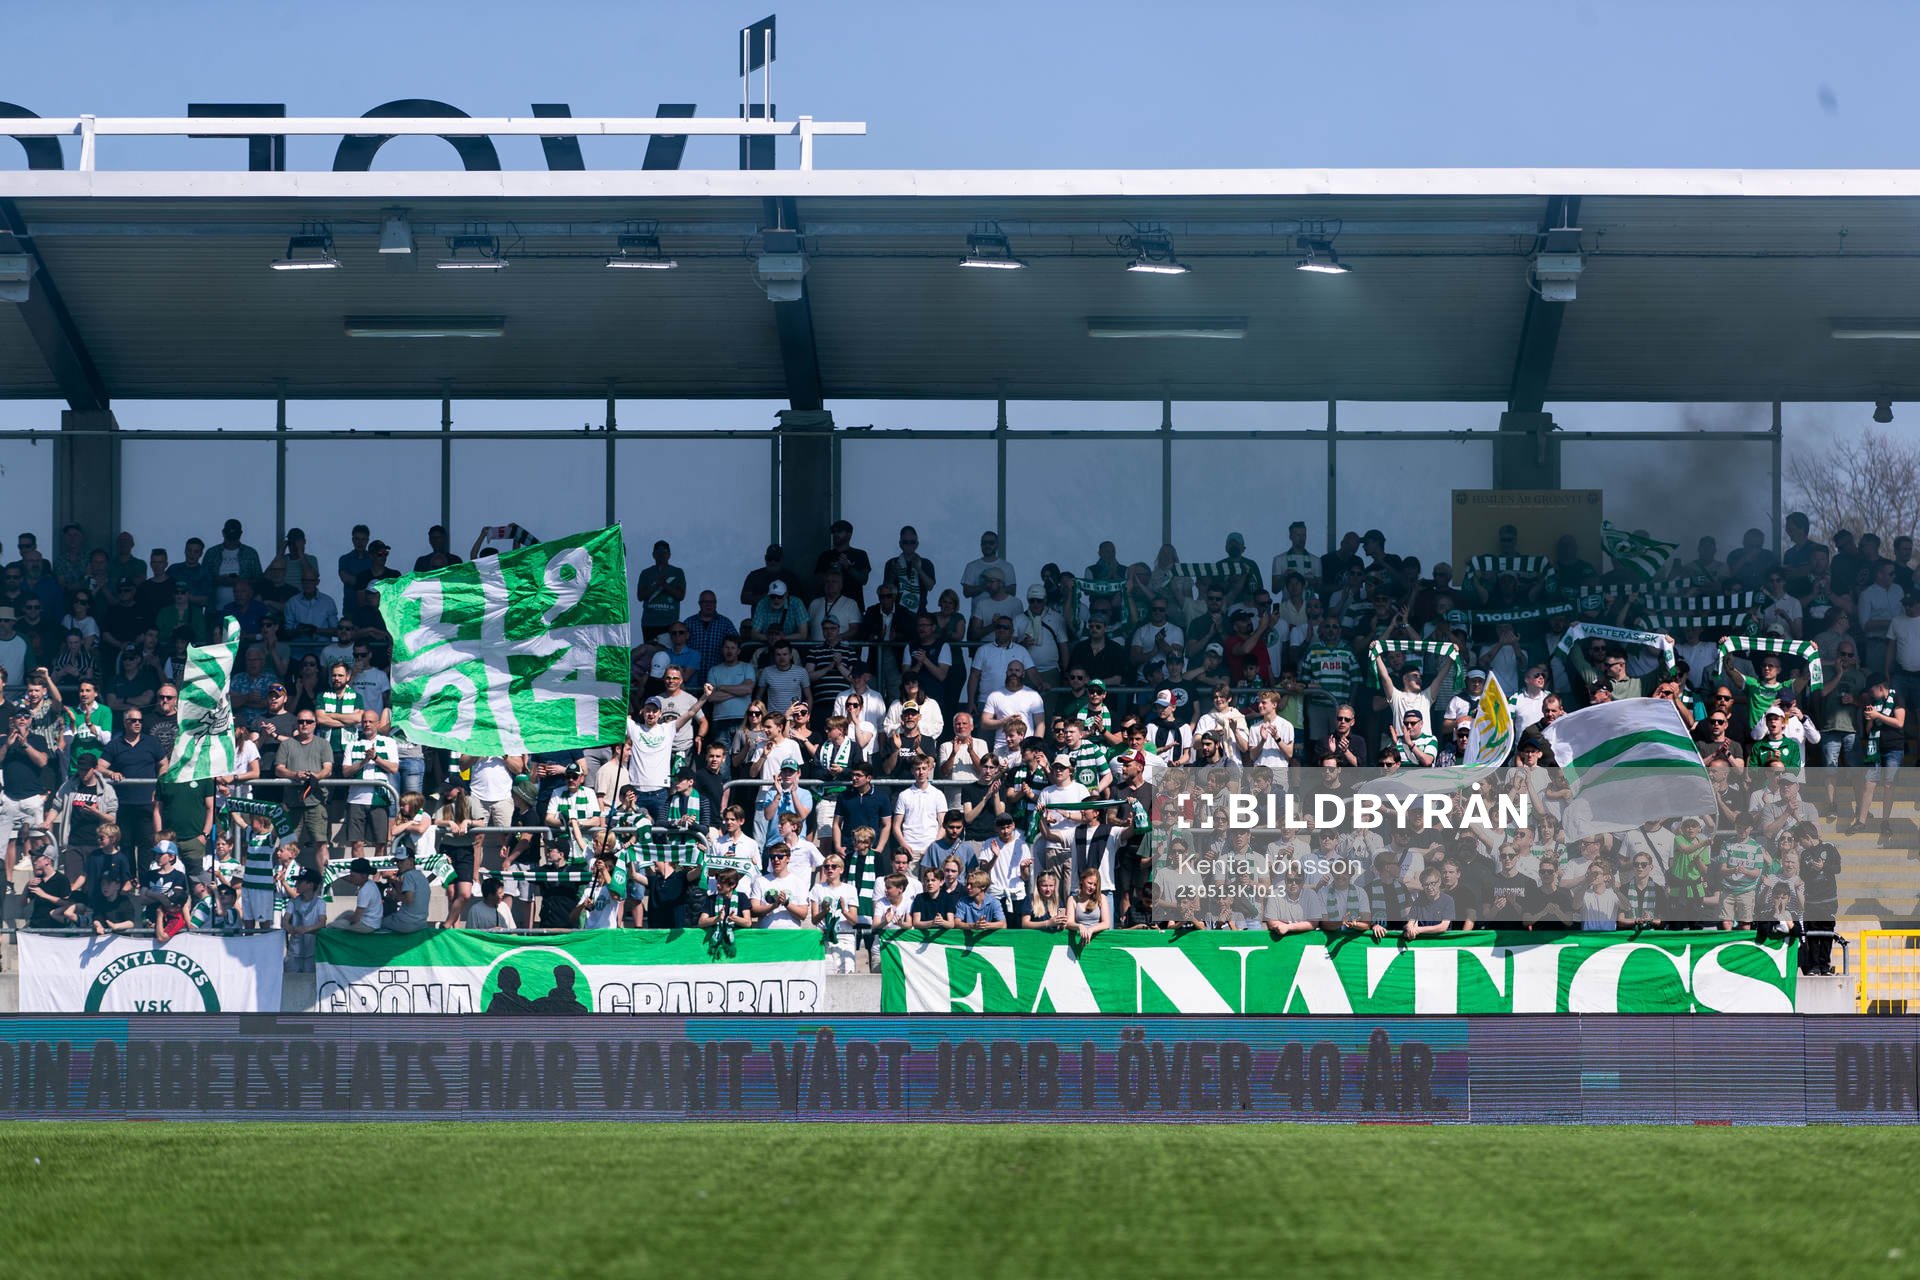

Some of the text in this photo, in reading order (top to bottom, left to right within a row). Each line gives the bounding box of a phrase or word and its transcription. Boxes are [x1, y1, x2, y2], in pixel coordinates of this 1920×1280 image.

[1645, 635, 1658, 644] SK
[1322, 661, 1341, 670] ABB
[98, 951, 209, 987] GRYTA BOYS
[880, 941, 1796, 1013] FANATICS
[134, 999, 173, 1012] VSK
[88, 1040, 448, 1110] ARBETSPLATS
[468, 1041, 577, 1110] HAR
[595, 1041, 752, 1110] VARIT
[769, 1026, 911, 1111] VÅRT
[930, 1041, 1059, 1111] JOBB
[1082, 1041, 1097, 1110] I
[1117, 1026, 1251, 1112] ÖVER
[1271, 1041, 1342, 1112] 40
[1836, 1042, 1920, 1111] DIN
